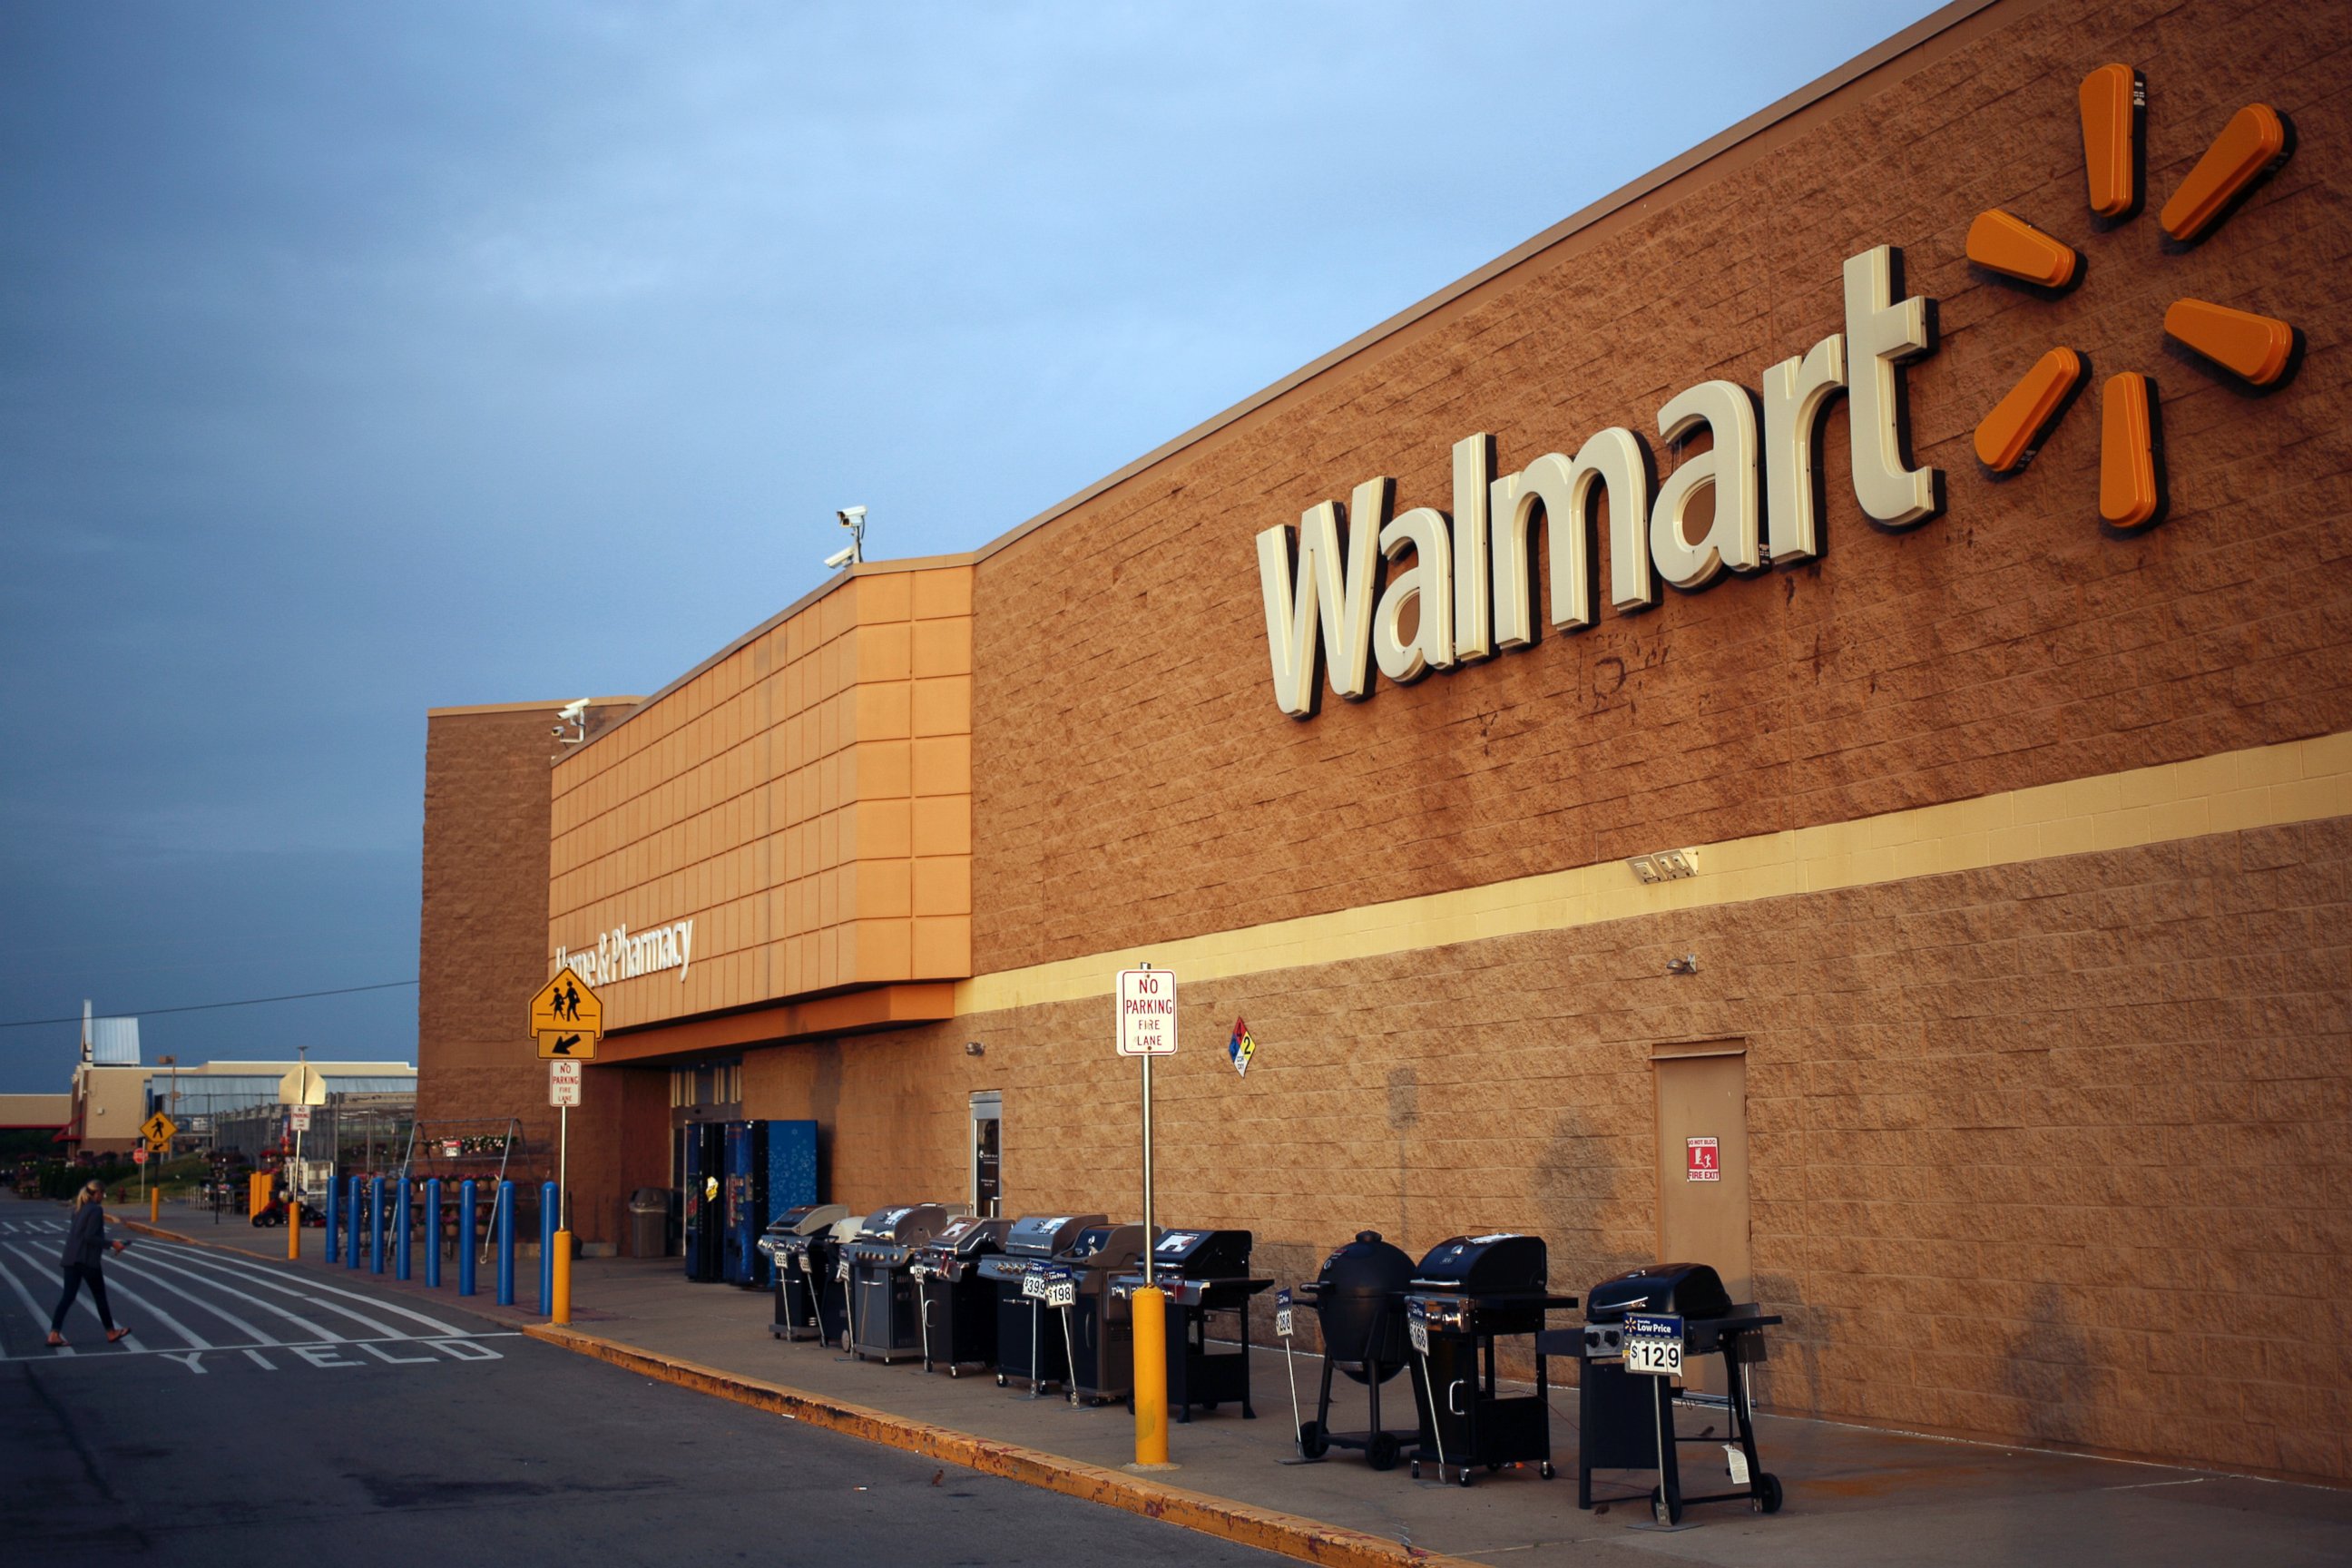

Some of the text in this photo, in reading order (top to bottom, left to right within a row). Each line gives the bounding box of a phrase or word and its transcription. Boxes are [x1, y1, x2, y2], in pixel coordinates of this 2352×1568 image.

[1257, 243, 1946, 720] Walmart
[597, 932, 611, 986] &
[611, 919, 693, 984] Pharmacy
[1139, 979, 1159, 995] NO
[1125, 999, 1173, 1014] PARKING
[1138, 1019, 1161, 1031] FIRE
[1136, 1034, 1162, 1046] LANE
[1243, 1035, 1251, 1054] 2
[560, 1064, 572, 1074] NO
[552, 1076, 579, 1084] PARKING
[1689, 1171, 1719, 1180] FIRE EXIT
[1024, 1279, 1045, 1295] $399
[1048, 1287, 1071, 1302] $198
[1637, 1323, 1671, 1334] Low Price
[158, 1339, 505, 1374] YIELD
[1631, 1345, 1680, 1368] $129
